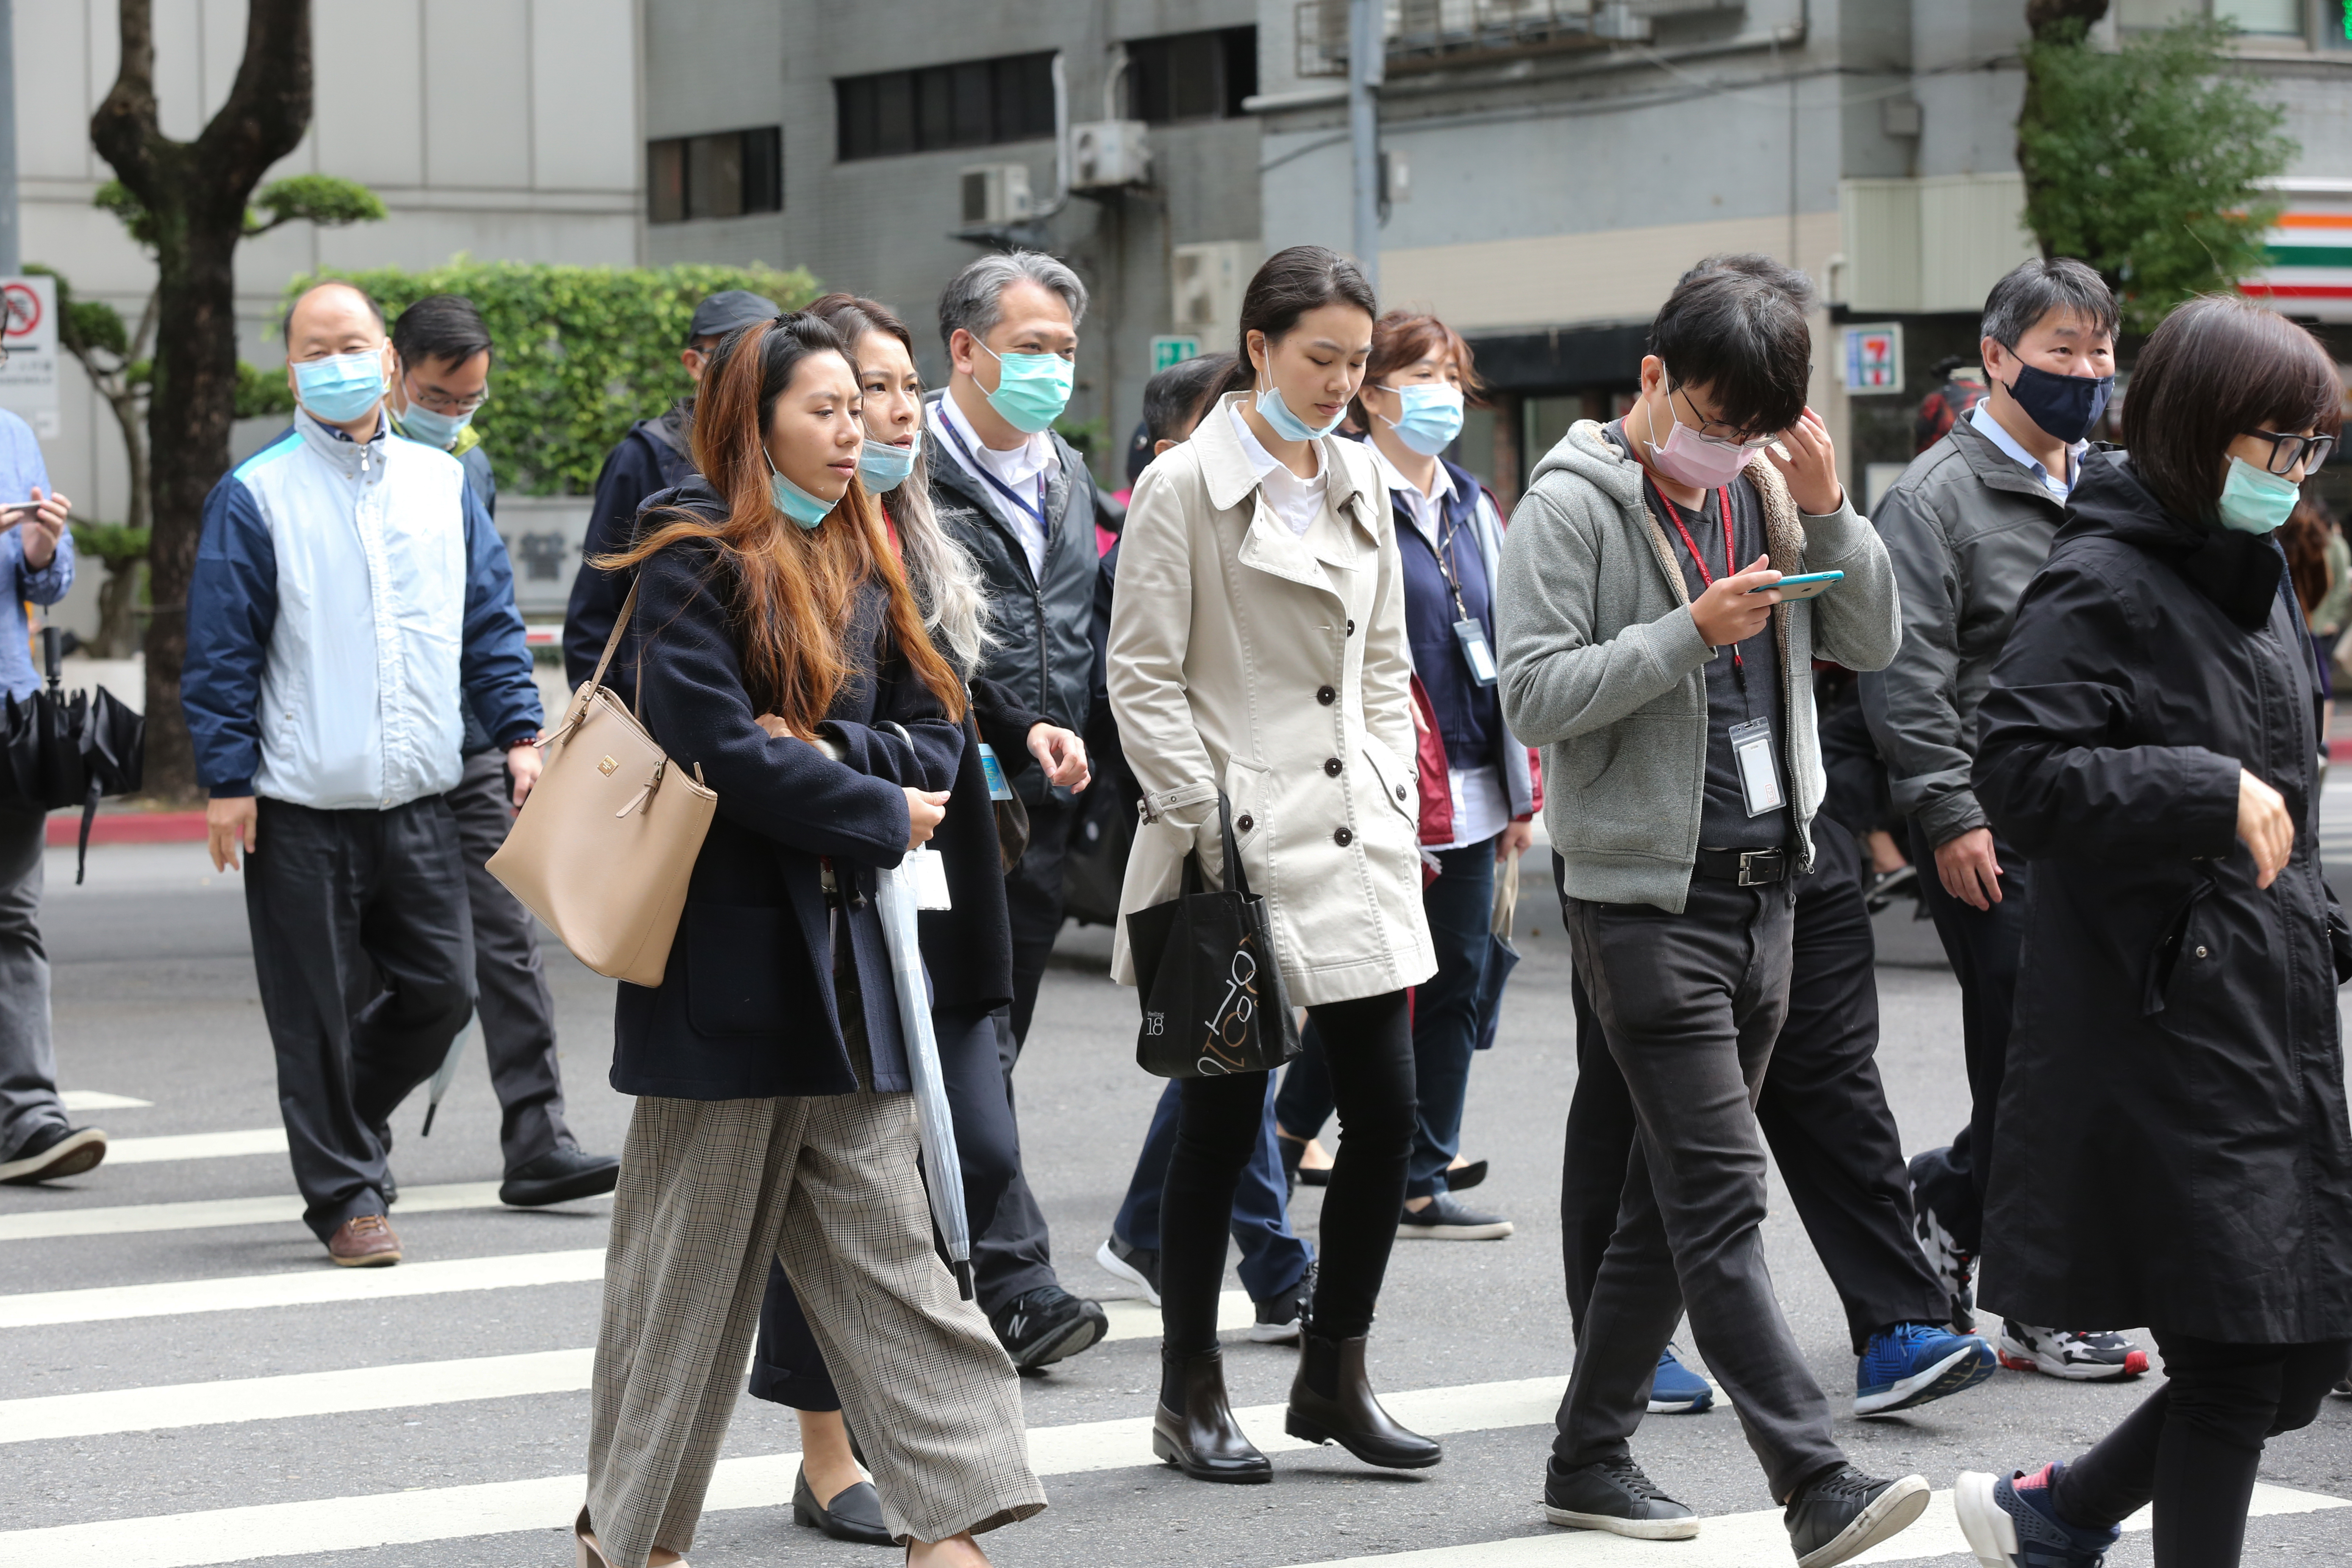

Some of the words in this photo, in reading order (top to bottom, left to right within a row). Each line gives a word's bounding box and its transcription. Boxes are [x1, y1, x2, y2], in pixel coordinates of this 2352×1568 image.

[1866, 340, 1886, 386] 7
[1669, 507, 1679, 521] Center
[1696, 556, 1709, 577] National
[1146, 1017, 1164, 1035] 18
[1008, 1314, 1028, 1338] N
